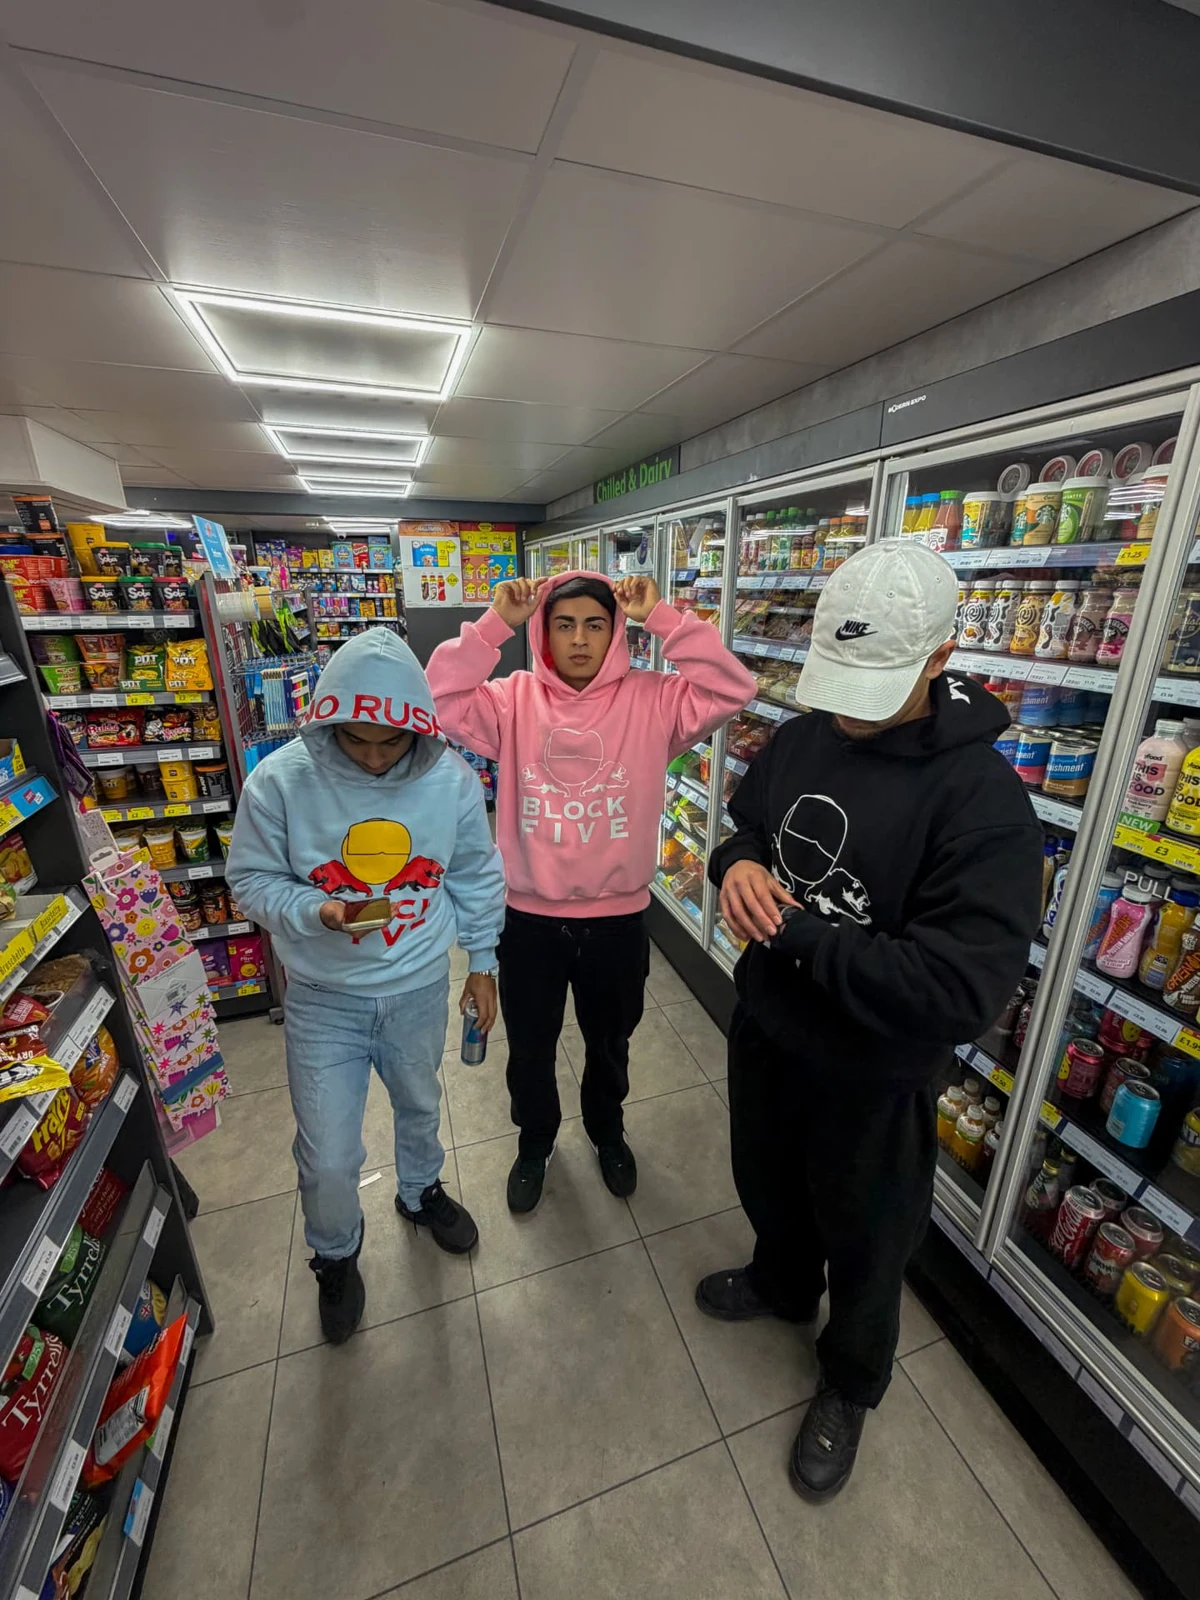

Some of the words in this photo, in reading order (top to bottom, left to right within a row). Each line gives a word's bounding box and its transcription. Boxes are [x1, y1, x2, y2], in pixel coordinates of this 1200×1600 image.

[910, 394, 927, 405] EXPO
[596, 470, 626, 504] Chilled
[628, 467, 637, 492] &
[639, 456, 673, 488] Dairy
[1121, 551, 1142, 560] £1.25
[89, 587, 114, 600] Soba
[128, 587, 152, 600] Soba
[164, 587, 187, 600] Soba
[842, 620, 870, 634] NIKE
[134, 654, 158, 667] POT
[172, 656, 197, 667] POT
[120, 680, 141, 690] POT
[168, 680, 188, 690] POT
[1134, 760, 1159, 776] THIS
[1132, 771, 1142, 781] IS
[1128, 780, 1165, 797] FOOD
[522, 796, 627, 821] BLOCK
[1120, 814, 1154, 832] NEW
[519, 816, 629, 844] FIVE
[1155, 845, 1170, 857] £3
[1123, 870, 1175, 904] PULL
[1166, 950, 1200, 990] GRENAD
[16, 1050, 35, 1061] DRY
[991, 1074, 1007, 1088] £2.50
